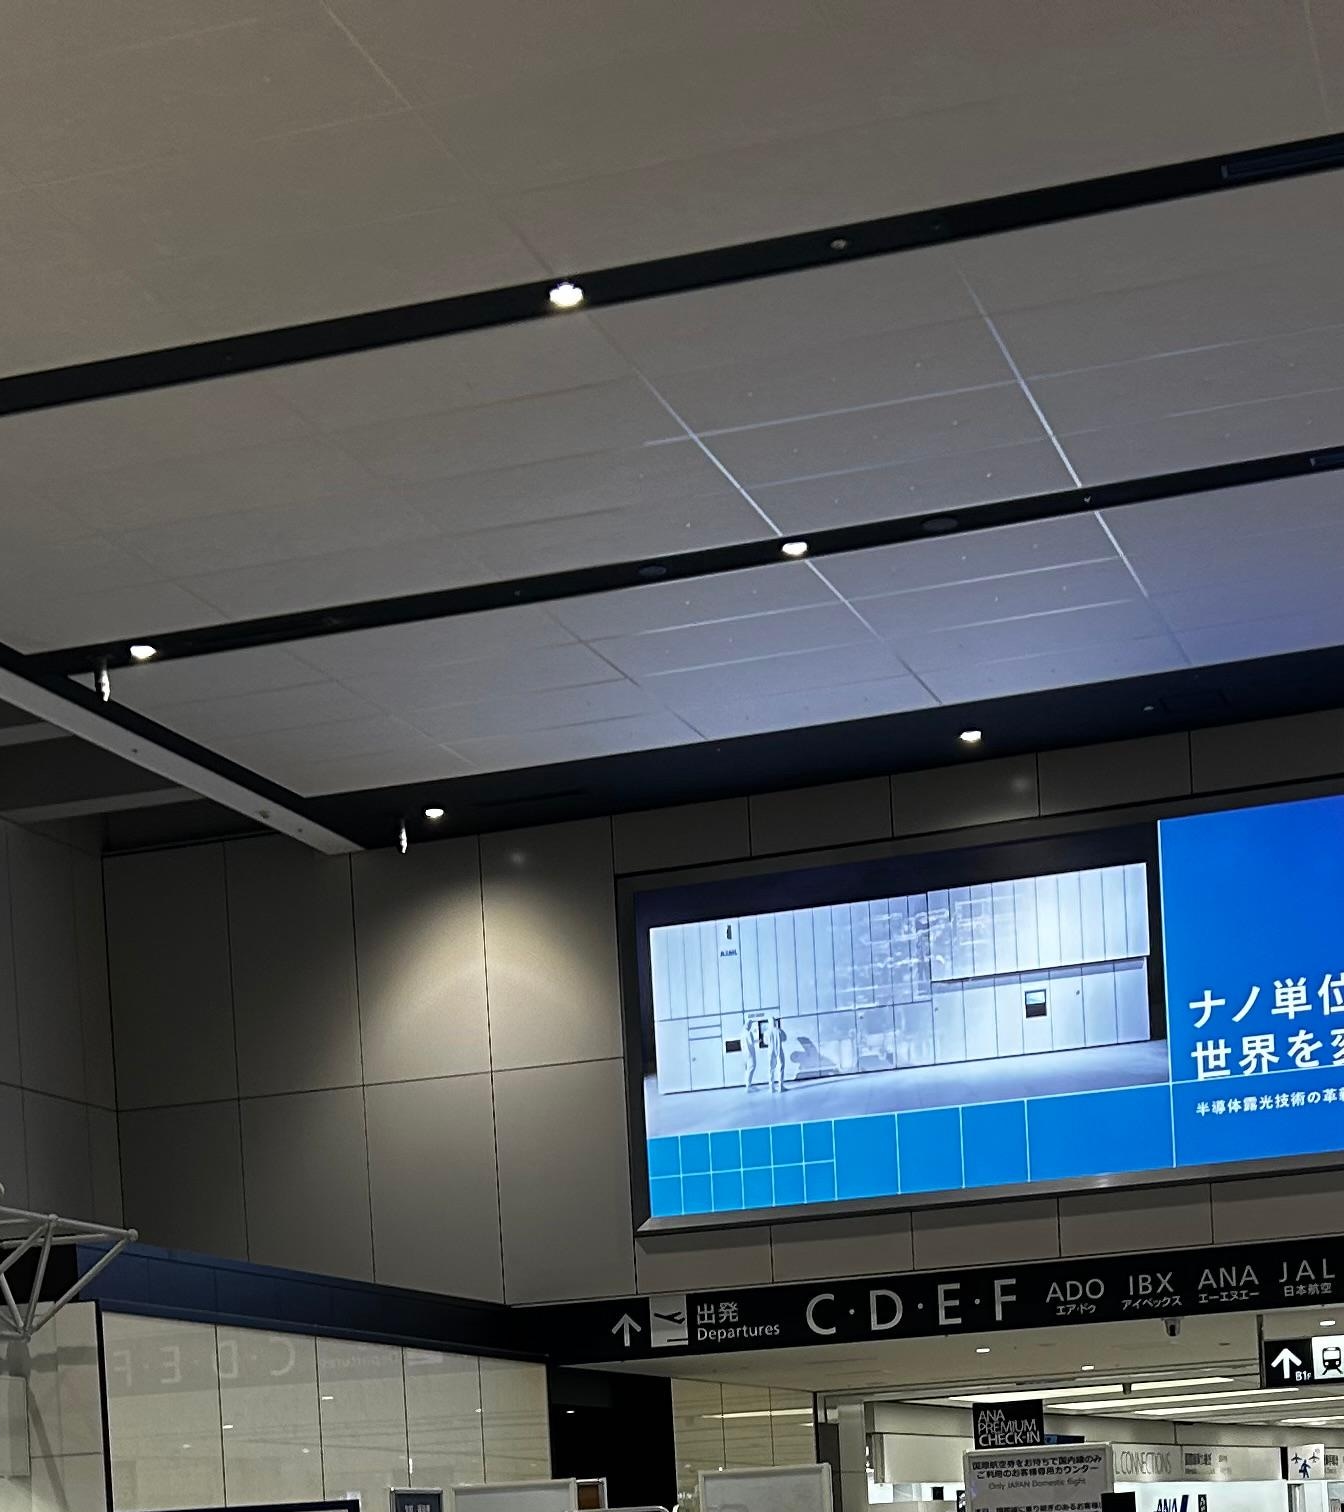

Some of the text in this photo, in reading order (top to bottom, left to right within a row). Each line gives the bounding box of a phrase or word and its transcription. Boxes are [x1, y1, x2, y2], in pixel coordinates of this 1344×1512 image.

[1197, 1265, 1260, 1290] ANA
[1279, 1258, 1336, 1283] JAL
[1046, 1278, 1105, 1304] ADO
[1129, 1272, 1175, 1296] IBX
[1284, 1282, 1332, 1297] 日本航空
[1121, 1295, 1183, 1311] アイベックス
[697, 1301, 739, 1325] 出発
[697, 1324, 780, 1342] Departures
[978, 1409, 1005, 1422] ANA
[978, 1419, 1037, 1434] PREMIUM
[979, 1430, 1041, 1447] CHECK-IN
[1067, 1478, 1086, 1488] flight
